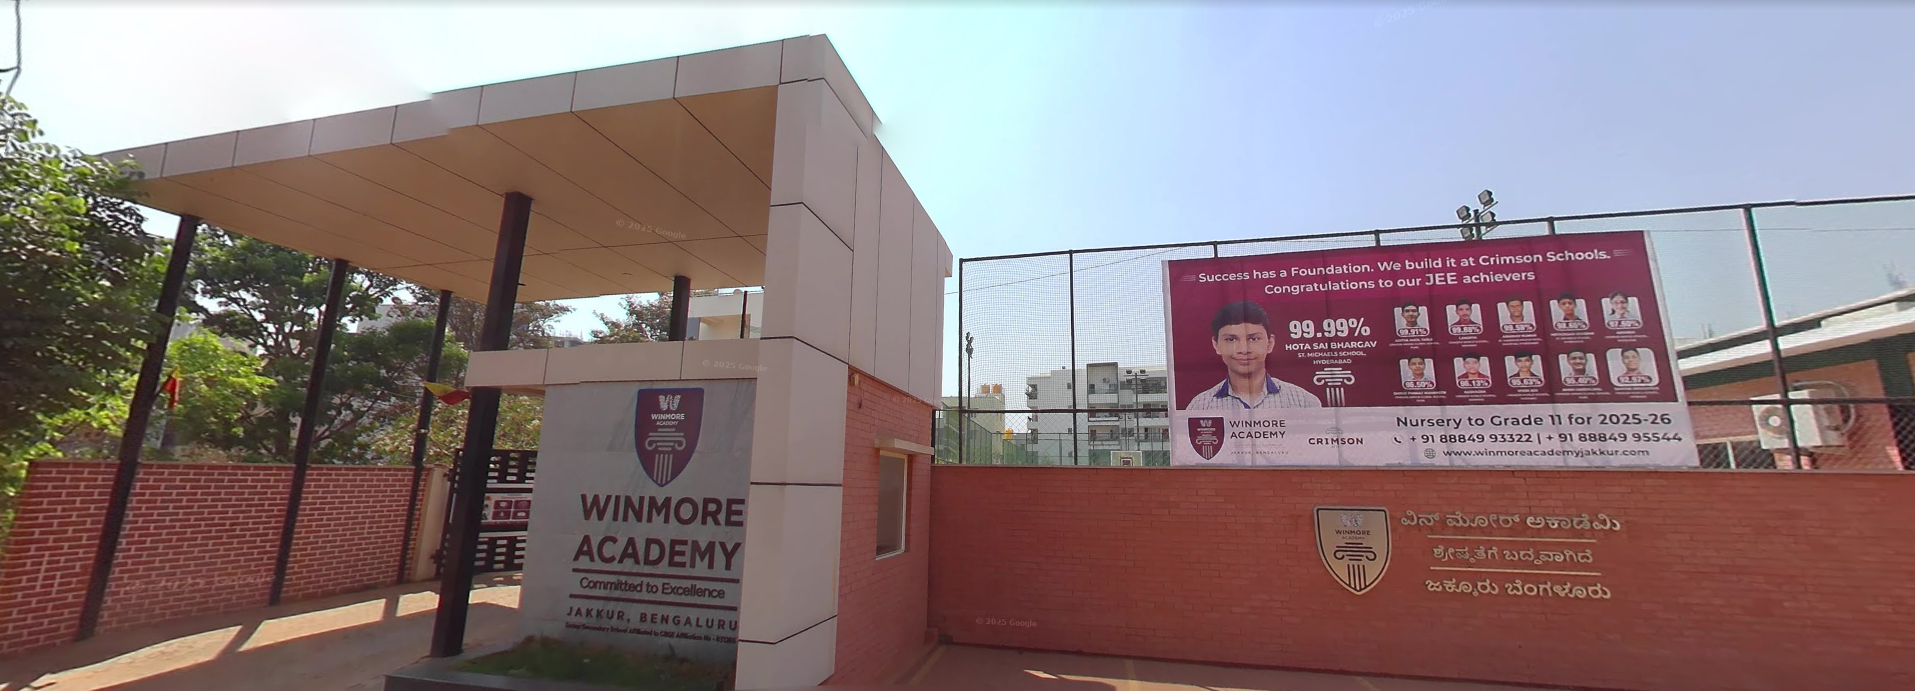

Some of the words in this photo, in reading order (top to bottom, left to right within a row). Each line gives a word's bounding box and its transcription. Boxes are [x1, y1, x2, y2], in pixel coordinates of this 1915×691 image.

[1198, 272, 1250, 283] Success
[1253, 269, 1276, 280] has
[1279, 270, 1287, 278] a
[1291, 262, 1374, 277] Foundation.
[1378, 261, 1402, 272] We
[1405, 258, 1442, 270] build
[1446, 256, 1456, 268] it
[1460, 256, 1475, 267] at
[1478, 253, 1543, 266] Crimson
[1546, 249, 1610, 262] Schools.
[1264, 278, 1375, 295] Congratulations
[1378, 278, 1393, 288] to
[1396, 277, 1421, 288] our
[1425, 272, 1458, 286] JEE
[1462, 270, 1535, 284] achievers
[1289, 318, 1371, 339] 99.99%
[1331, 341, 1377, 349] BHARGAV
[1229, 420, 1286, 428] WINMORE
[1396, 416, 1462, 429] Nursery
[1467, 416, 1485, 426] to
[1490, 414, 1543, 426] Grade
[1548, 414, 1562, 425] 11
[1568, 414, 1592, 425] for
[1598, 414, 1672, 425] 2025-26
[1421, 434, 1435, 443] 91
[1440, 434, 1485, 443] 88849
[1489, 433, 1533, 443] 93322
[1558, 433, 1573, 442] 91
[1578, 433, 1627, 442] 88849
[1632, 433, 1682, 442] 95544
[1442, 448, 1650, 458] www.winmoreacademyjakkur.com
[580, 493, 746, 527] WINMORE
[573, 535, 742, 571] ACADEMY
[580, 576, 643, 594] Committed
[645, 582, 658, 594] to
[662, 582, 725, 599] Excellence
[567, 606, 630, 623] JAKKUR,
[640, 612, 738, 631] BENGALURU
